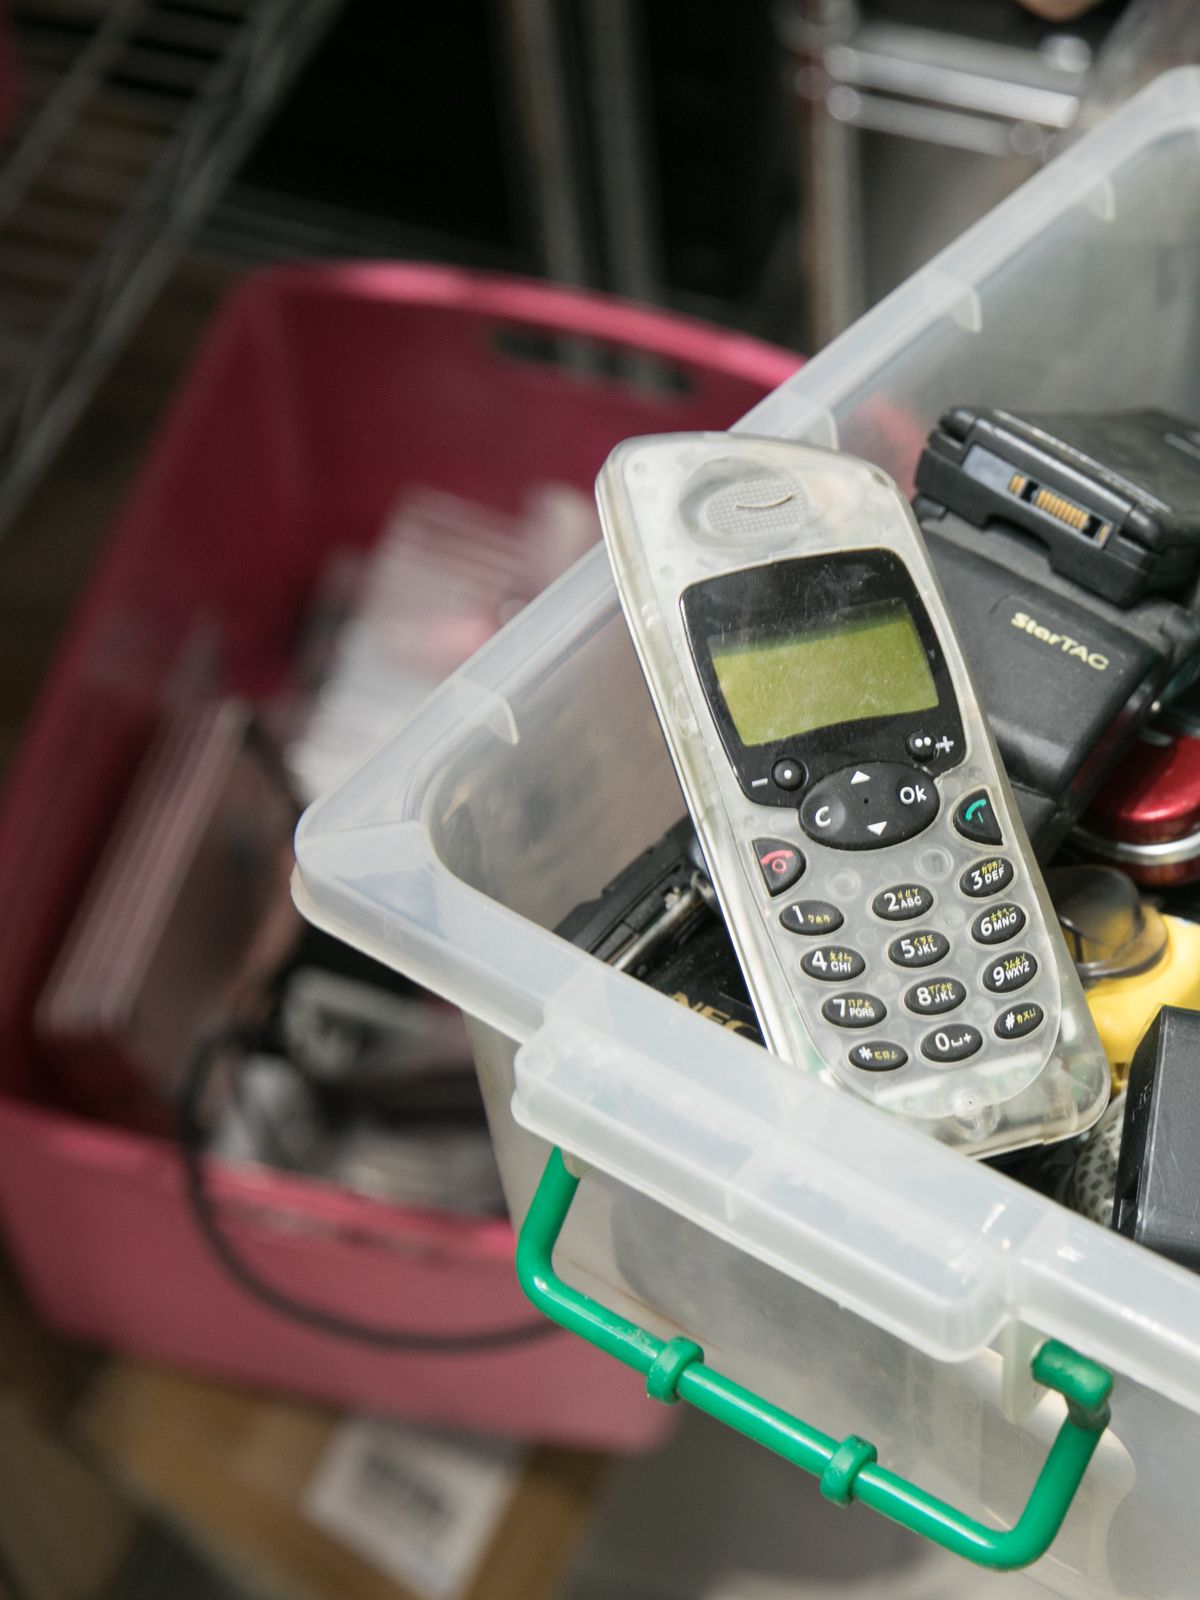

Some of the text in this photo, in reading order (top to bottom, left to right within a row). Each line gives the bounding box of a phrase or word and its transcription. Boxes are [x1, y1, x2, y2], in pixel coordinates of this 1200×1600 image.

[1011, 612, 1109, 670] StarTAC
[814, 806, 832, 827] C
[971, 870, 983, 891] 3
[984, 867, 1005, 885] DEF
[884, 892, 900, 912] 2
[900, 895, 922, 910] ABC
[792, 905, 805, 924] 1
[992, 912, 1017, 932] MNO
[980, 916, 993, 937] 6
[900, 939, 916, 959] 5
[917, 943, 938, 956] JKL
[811, 951, 828, 972] 4
[1005, 961, 1031, 981] WXYZ
[992, 966, 1005, 987] 9
[916, 986, 932, 1007] 8
[832, 998, 846, 1018] 7
[934, 1032, 950, 1052] 0
